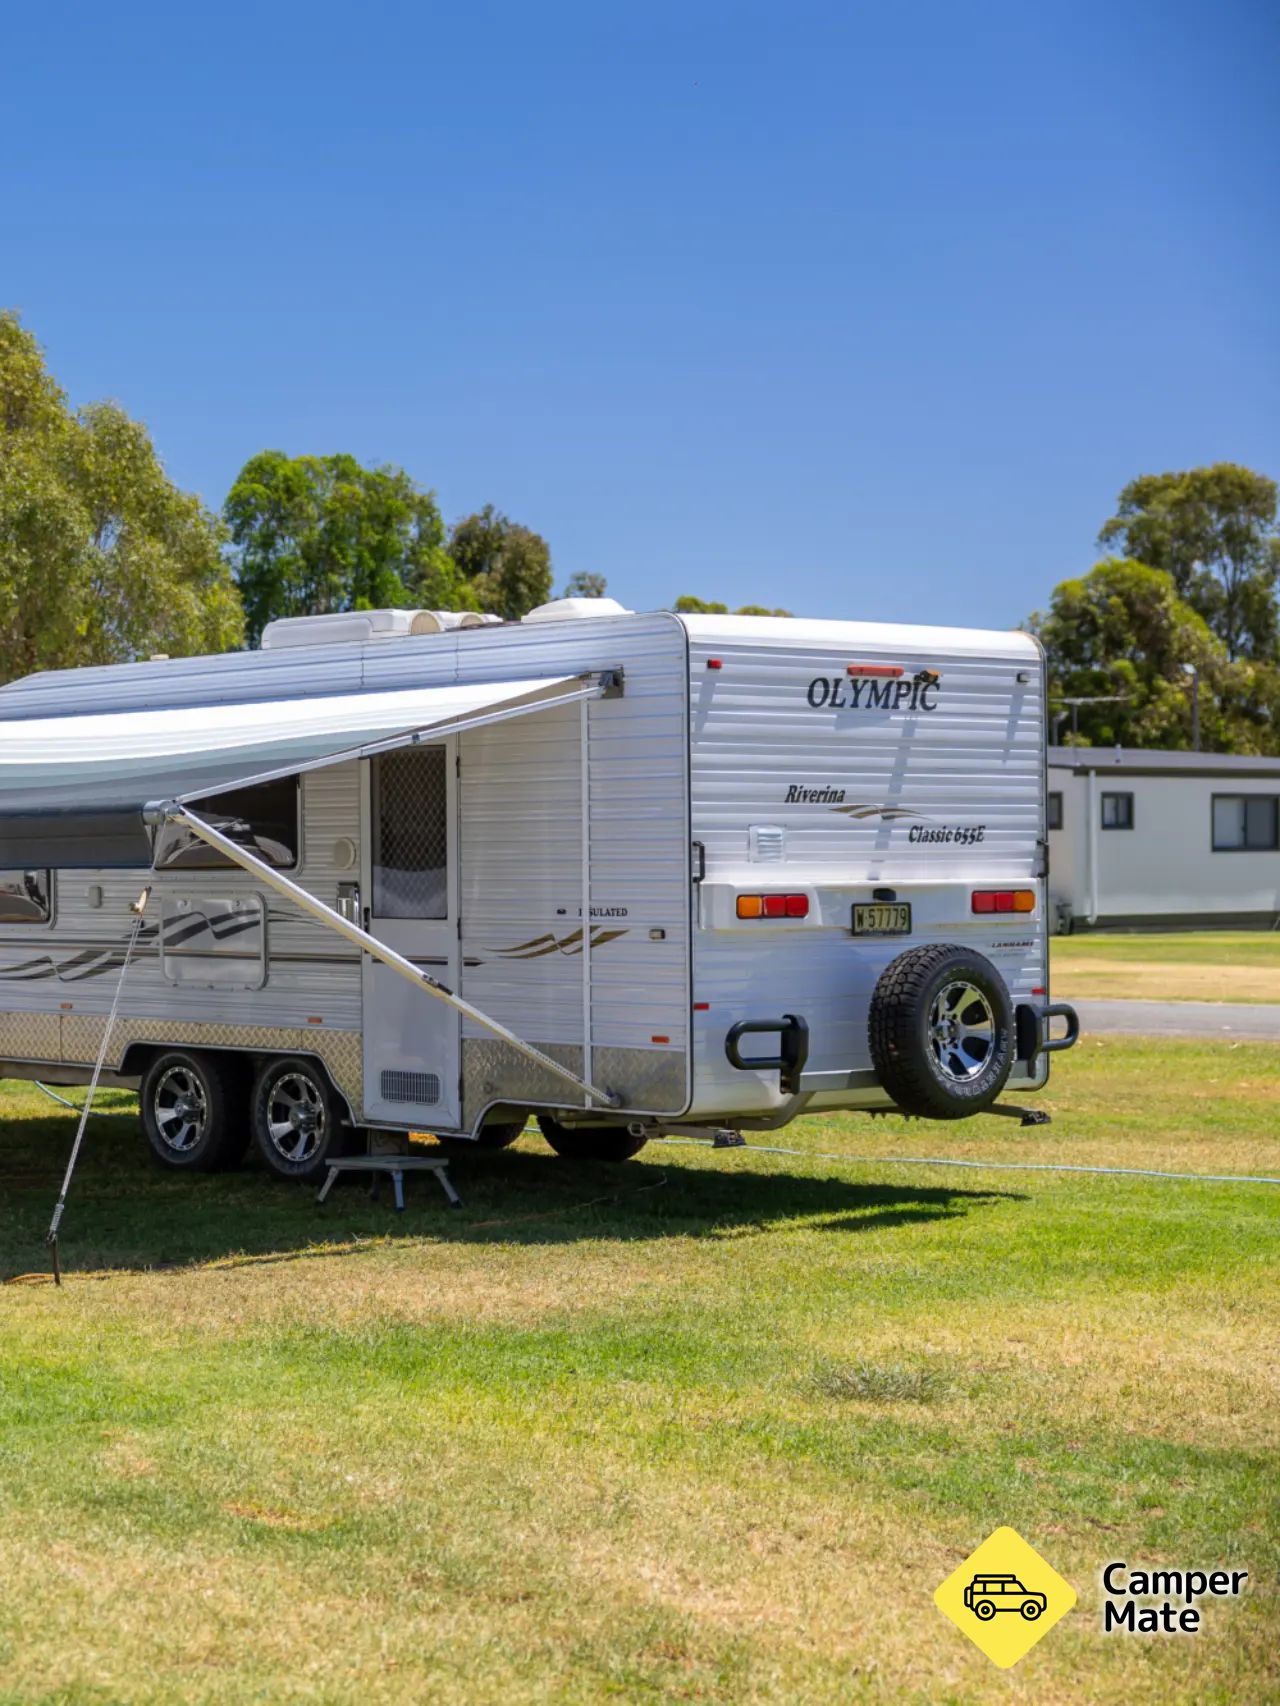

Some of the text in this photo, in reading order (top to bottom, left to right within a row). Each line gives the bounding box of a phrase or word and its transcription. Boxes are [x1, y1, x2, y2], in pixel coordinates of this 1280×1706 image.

[807, 677, 940, 711] OLYMPIC
[785, 785, 846, 804] Riverina
[908, 825, 954, 843] Classic
[578, 908, 629, 917] ISULATED
